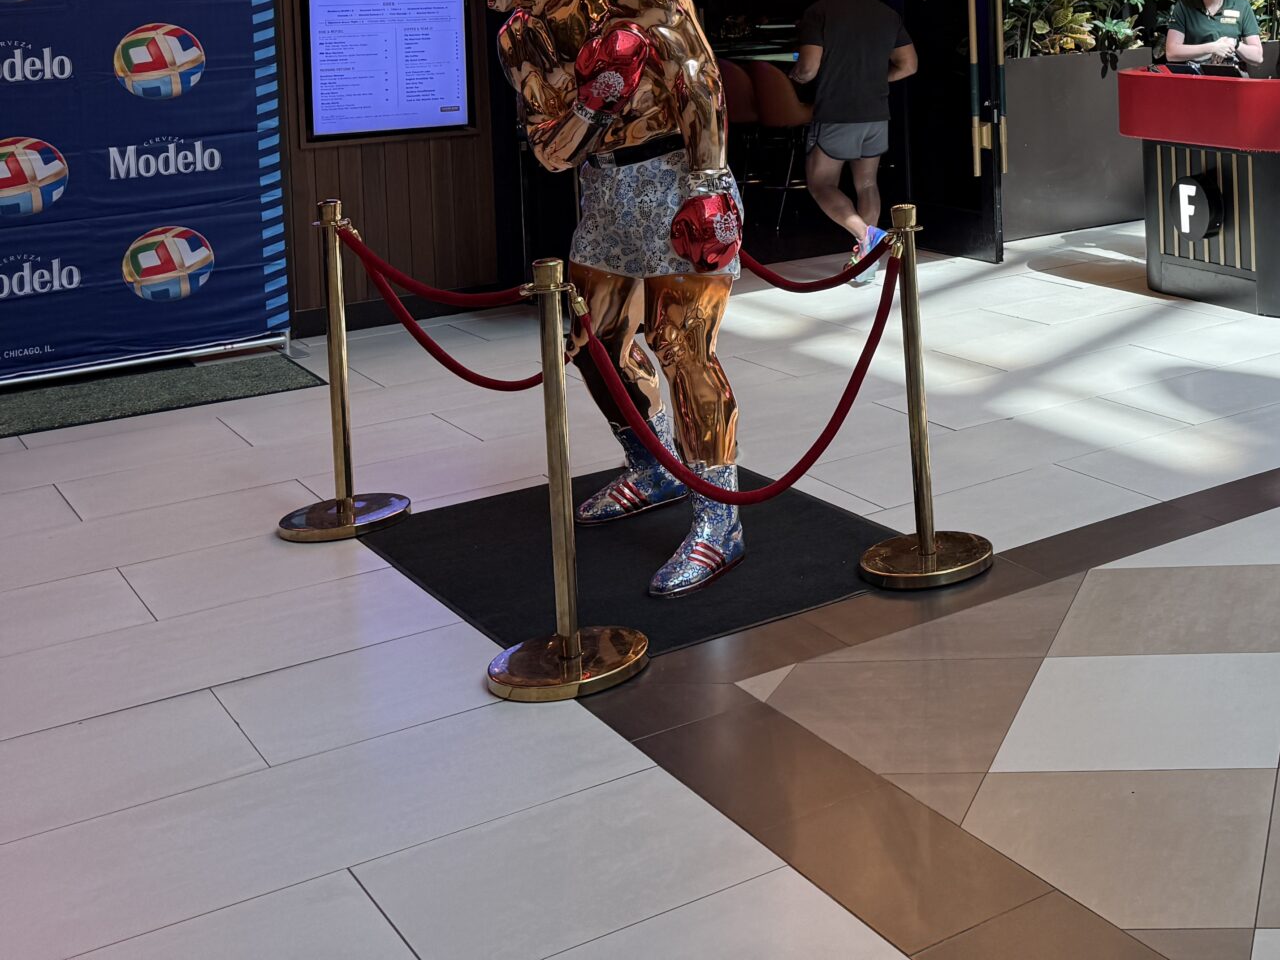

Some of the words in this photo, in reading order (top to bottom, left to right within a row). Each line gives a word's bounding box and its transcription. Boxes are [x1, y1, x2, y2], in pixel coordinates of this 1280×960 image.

[0, 47, 73, 82] delo
[143, 135, 184, 147] CERVEZA
[108, 140, 222, 180] Modelo
[1178, 183, 1197, 234] F
[3, 346, 43, 359] CHICAGO,
[44, 344, 55, 353] IL.
